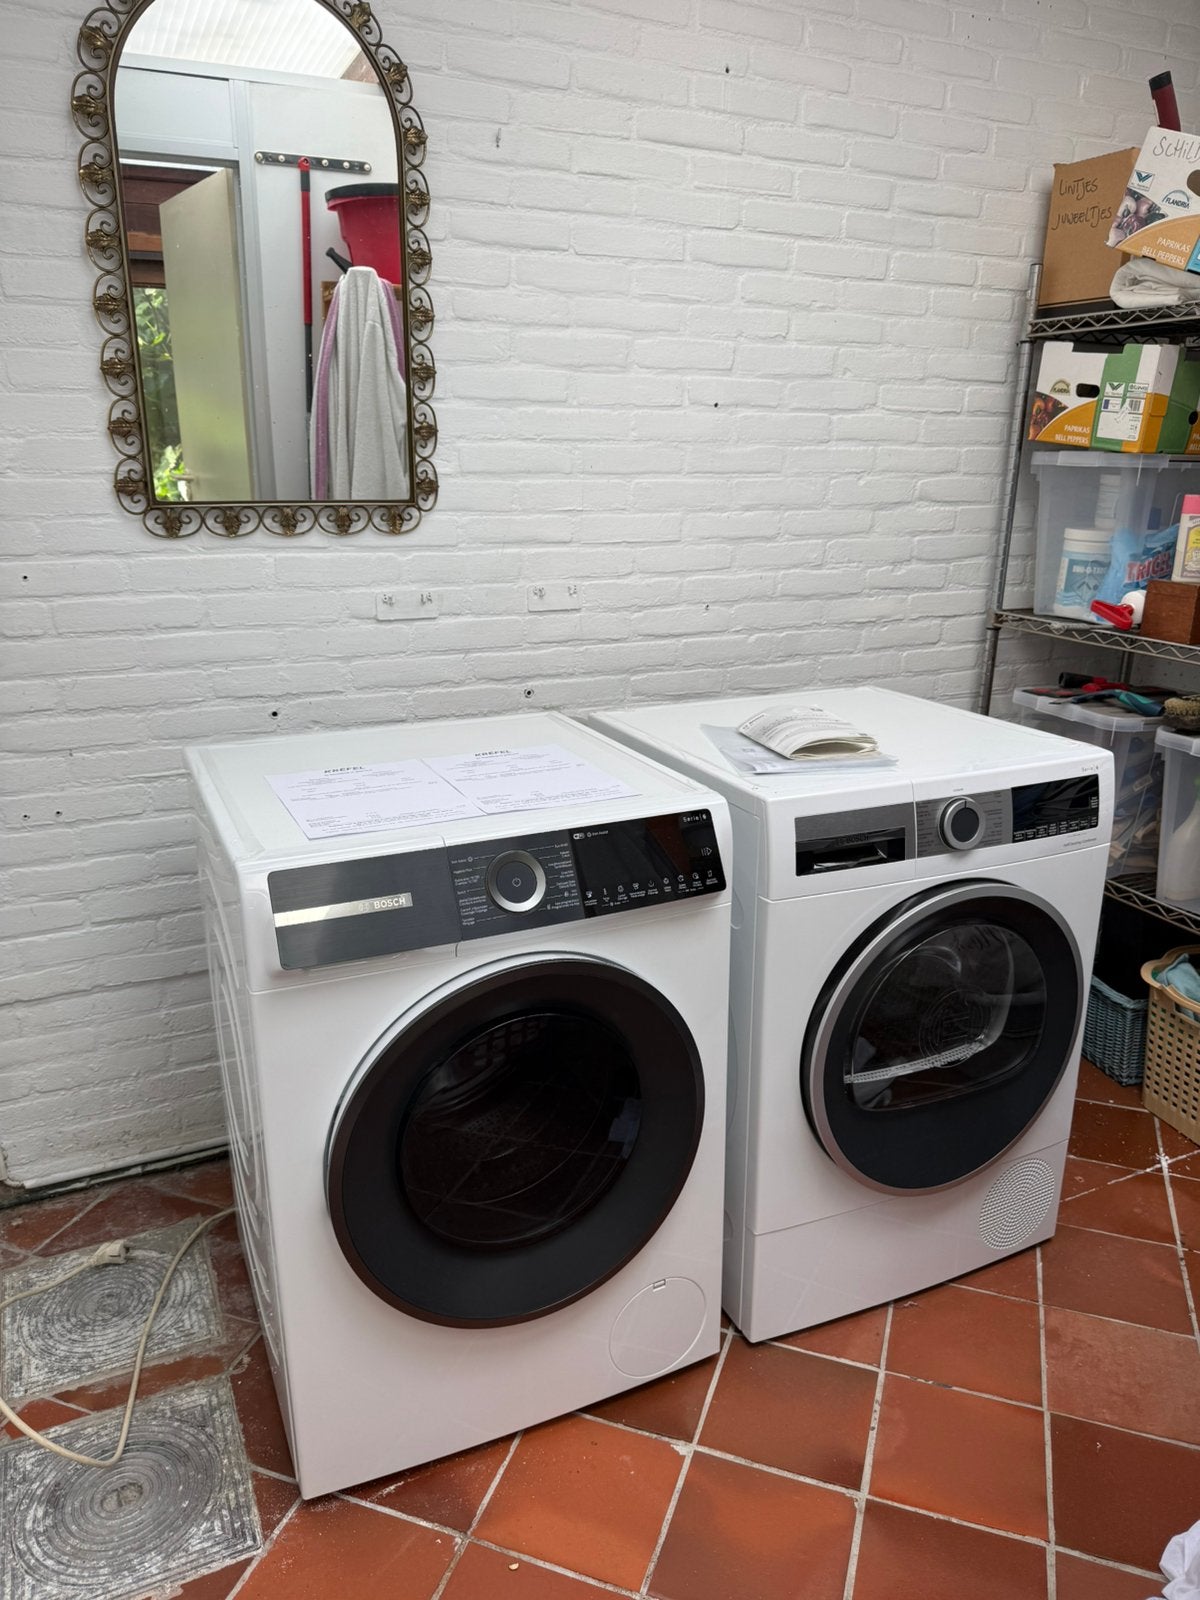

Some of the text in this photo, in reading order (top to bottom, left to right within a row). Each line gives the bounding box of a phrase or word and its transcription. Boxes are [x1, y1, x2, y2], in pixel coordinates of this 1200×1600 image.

[1165, 197, 1190, 209] FLANDRIA
[1157, 237, 1191, 252] PAPRIKAS
[1156, 250, 1185, 265] PEPPERS
[1064, 424, 1090, 433] PAPRIKAS
[1067, 435, 1089, 443] PEPPERS
[373, 897, 406, 909] BOSCH
